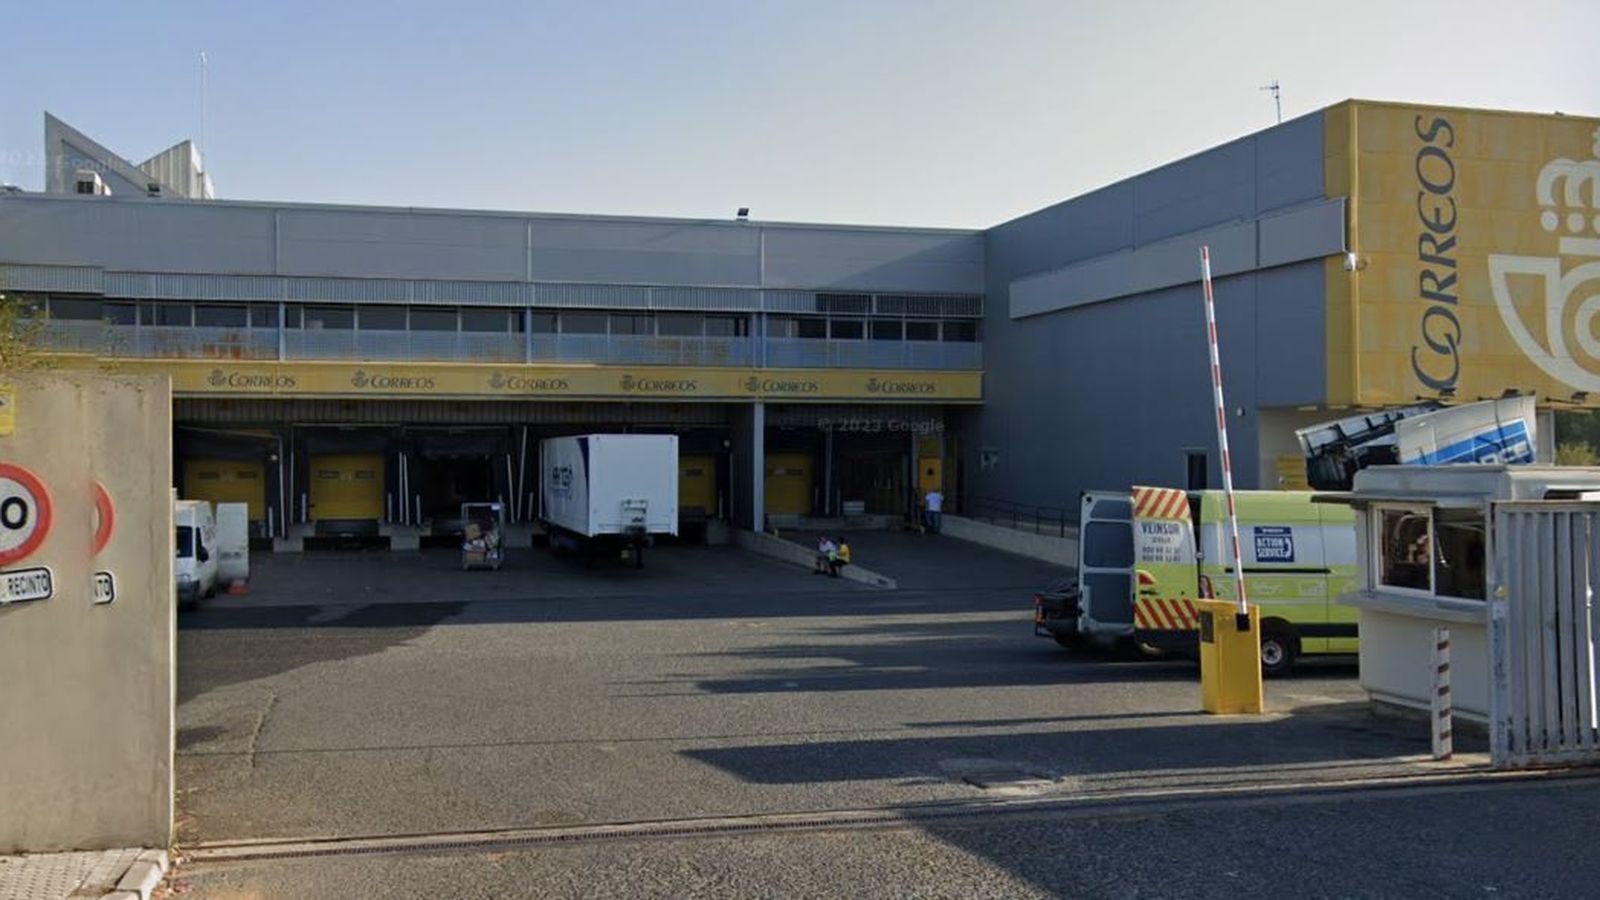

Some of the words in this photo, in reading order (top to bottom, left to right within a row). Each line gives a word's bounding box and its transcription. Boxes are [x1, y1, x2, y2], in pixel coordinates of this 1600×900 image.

[1412, 114, 1461, 390] CORREOS
[228, 372, 296, 388] CORREOS
[371, 374, 435, 389] CORREOS
[507, 376, 568, 390] CORREOS
[637, 379, 697, 392] CORREOS
[763, 380, 819, 393] CORREOS
[882, 381, 935, 393] CORREOS
[8, 573, 49, 595] RECINTO
